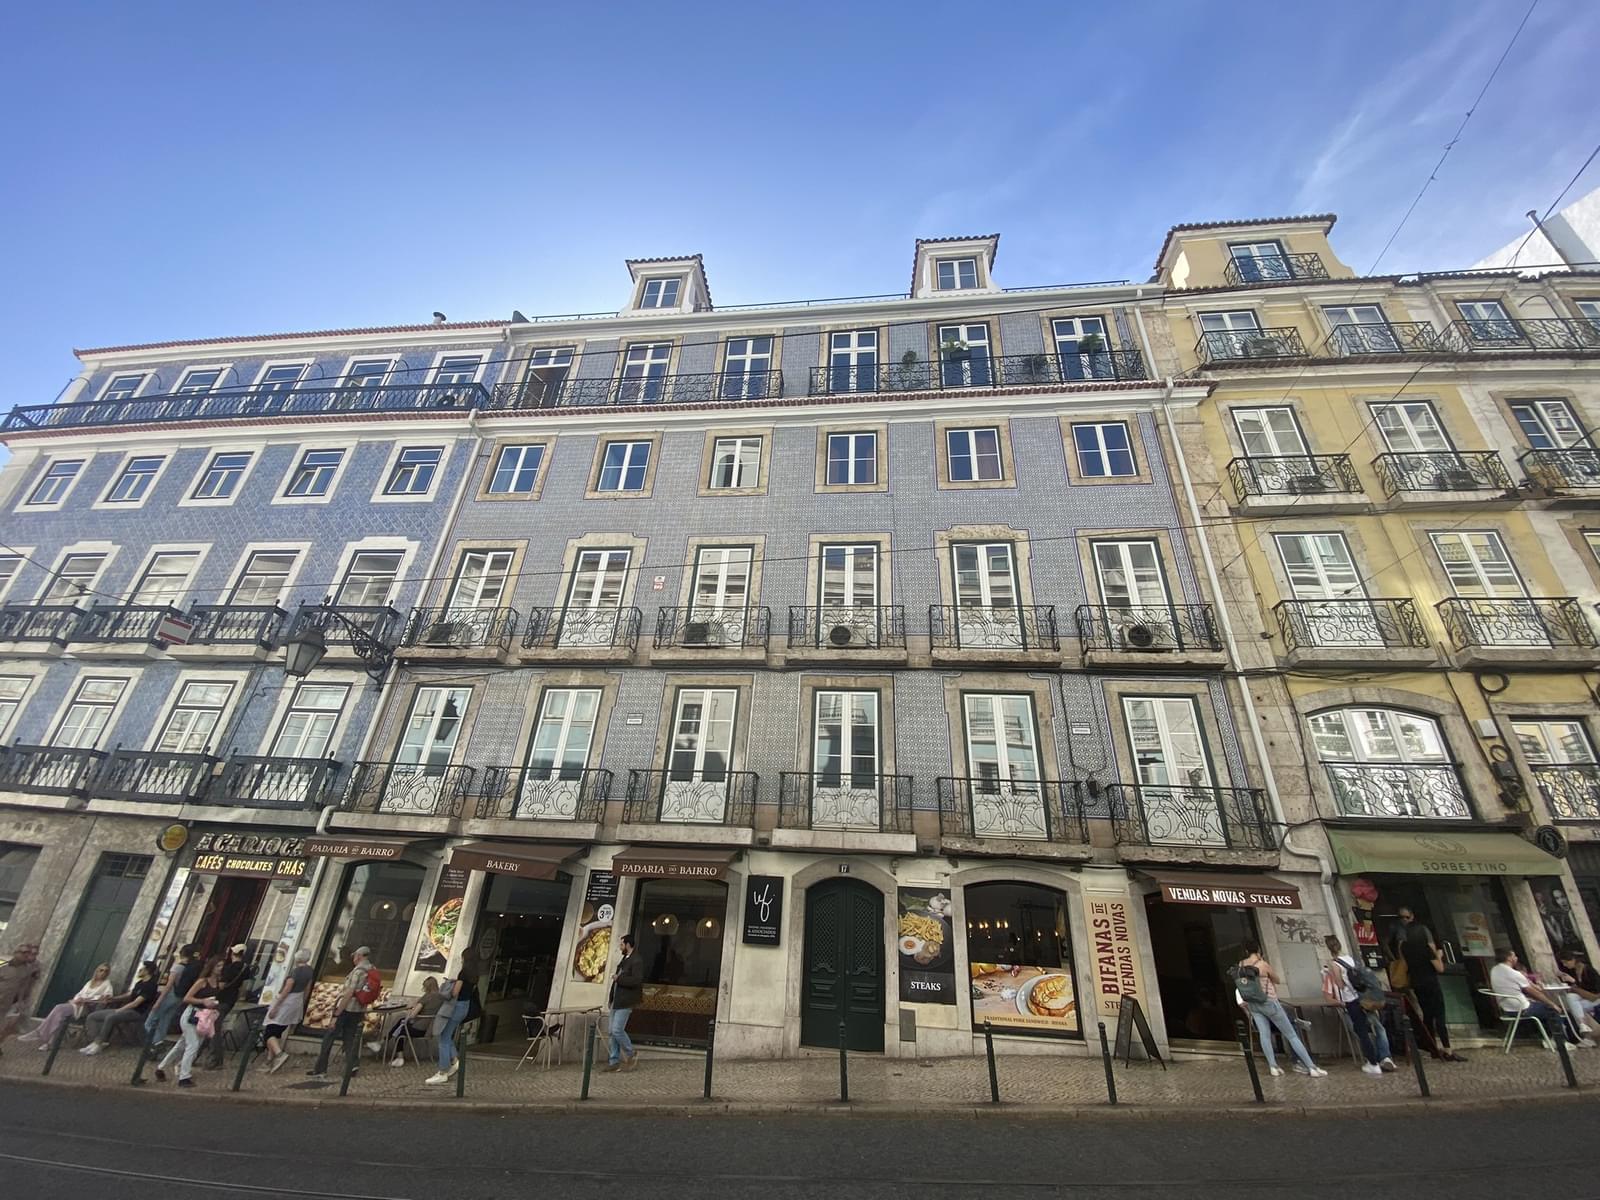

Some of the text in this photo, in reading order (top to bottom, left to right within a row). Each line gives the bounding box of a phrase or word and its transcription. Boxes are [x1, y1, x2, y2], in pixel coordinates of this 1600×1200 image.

[310, 844, 348, 854] PADARIA
[360, 847, 394, 857] BAIRRO
[194, 854, 305, 876] CAFÉS CHOCOLATES CHÁS
[486, 860, 520, 872] BAKERY
[621, 864, 665, 874] PADARIA
[680, 866, 717, 876] BAIRRO
[1421, 861, 1508, 872] SORBETTINO
[1168, 887, 1292, 905] VENDAS NOVAS STEAKS
[1093, 903, 1120, 995] BIFANAS DE
[1111, 903, 1137, 996] VENDAS NOVAS
[910, 981, 941, 991] STEAKS
